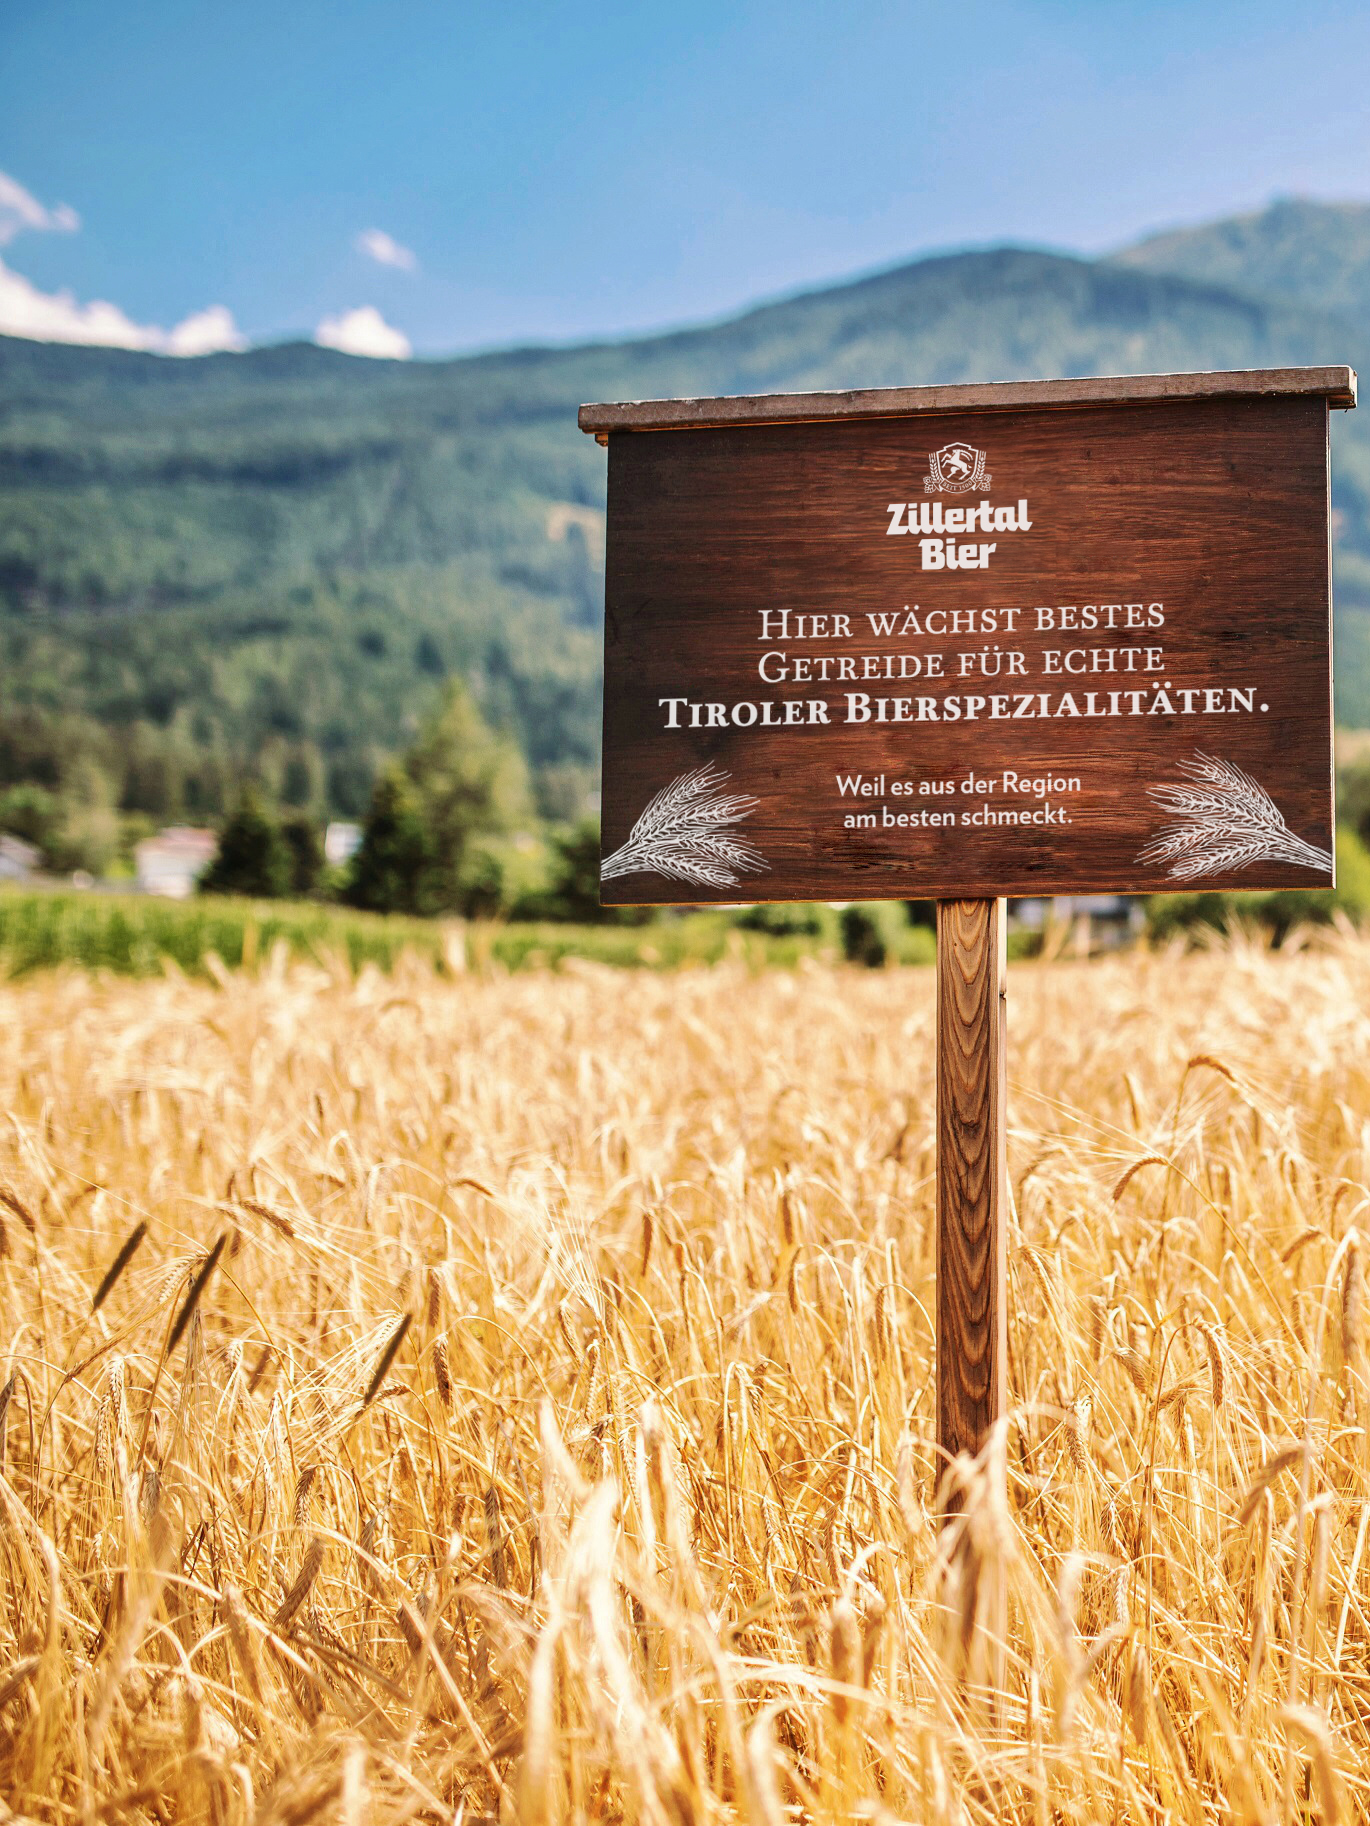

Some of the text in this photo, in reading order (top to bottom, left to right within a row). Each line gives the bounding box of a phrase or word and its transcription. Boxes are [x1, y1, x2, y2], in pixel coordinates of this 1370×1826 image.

[885, 498, 1033, 535] Zillertal
[917, 537, 997, 571] Bier
[757, 602, 1165, 640] HIER WÄCHST BESTES
[758, 645, 1165, 683] GETREIDE FÜR ECHTE
[658, 681, 1271, 729] TIROLER BIERSPEZIALITÄTEN.
[835, 770, 1082, 798] Weil es aus der Region
[843, 801, 1073, 829] am besten schmeckt.
